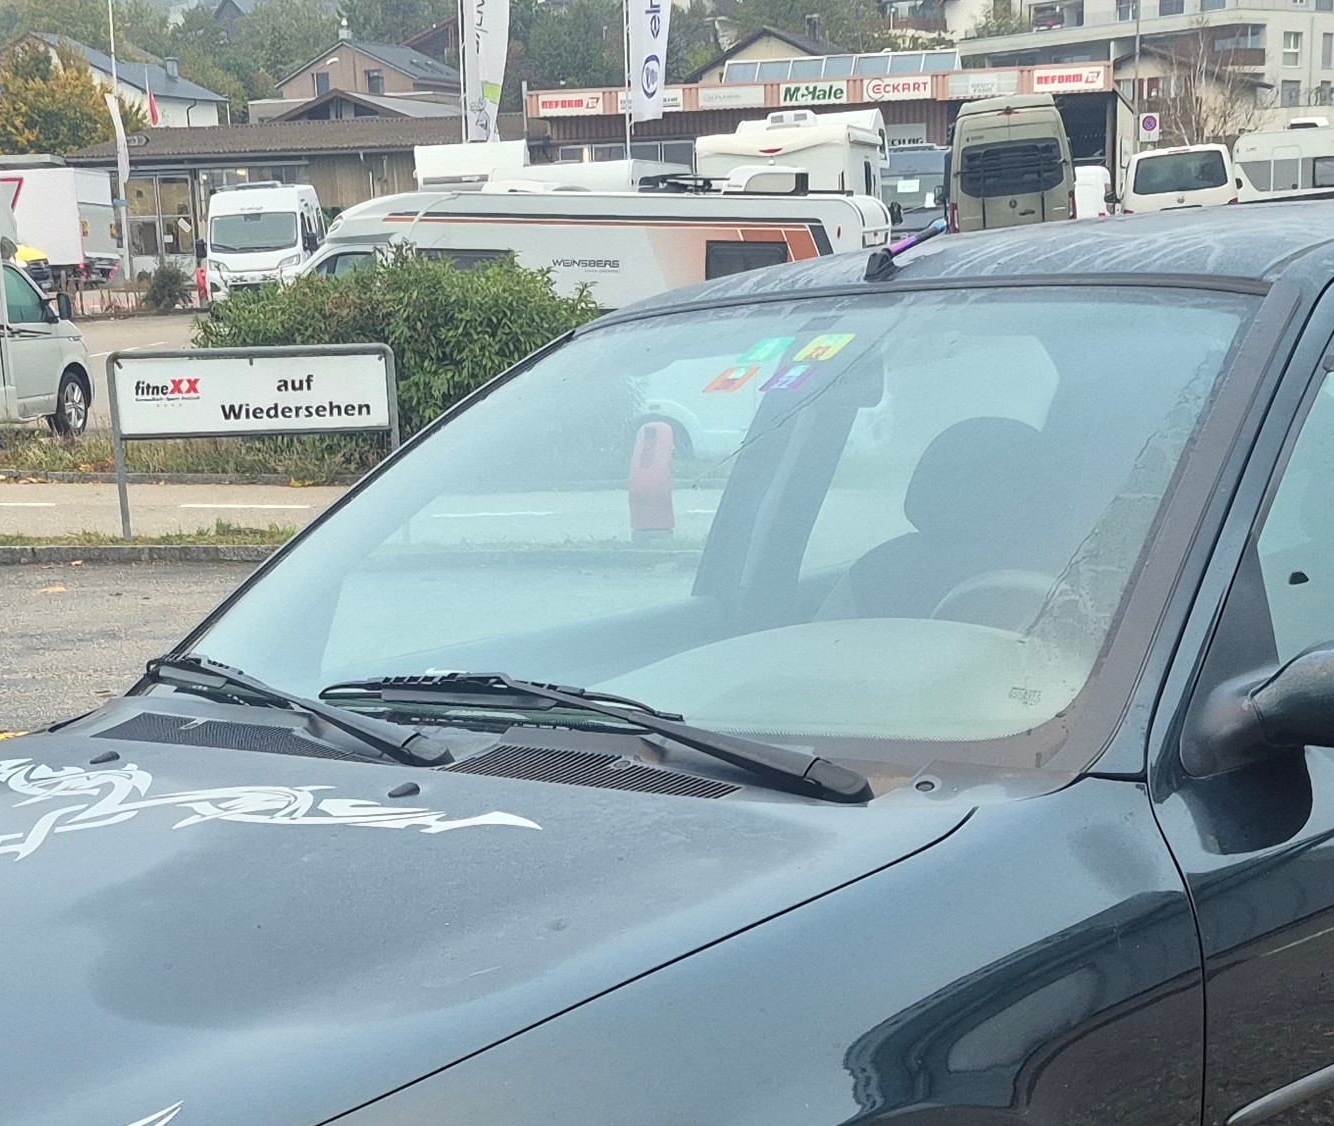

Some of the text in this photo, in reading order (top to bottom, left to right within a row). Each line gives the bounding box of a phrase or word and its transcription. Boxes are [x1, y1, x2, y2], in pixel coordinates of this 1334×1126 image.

[1036, 73, 1083, 85] REFORM
[871, 81, 929, 95] ECKART
[541, 98, 584, 110] REFORM
[552, 259, 620, 269] WEINSBERG
[276, 374, 315, 392] auf
[220, 401, 372, 421] Wiedersehen
